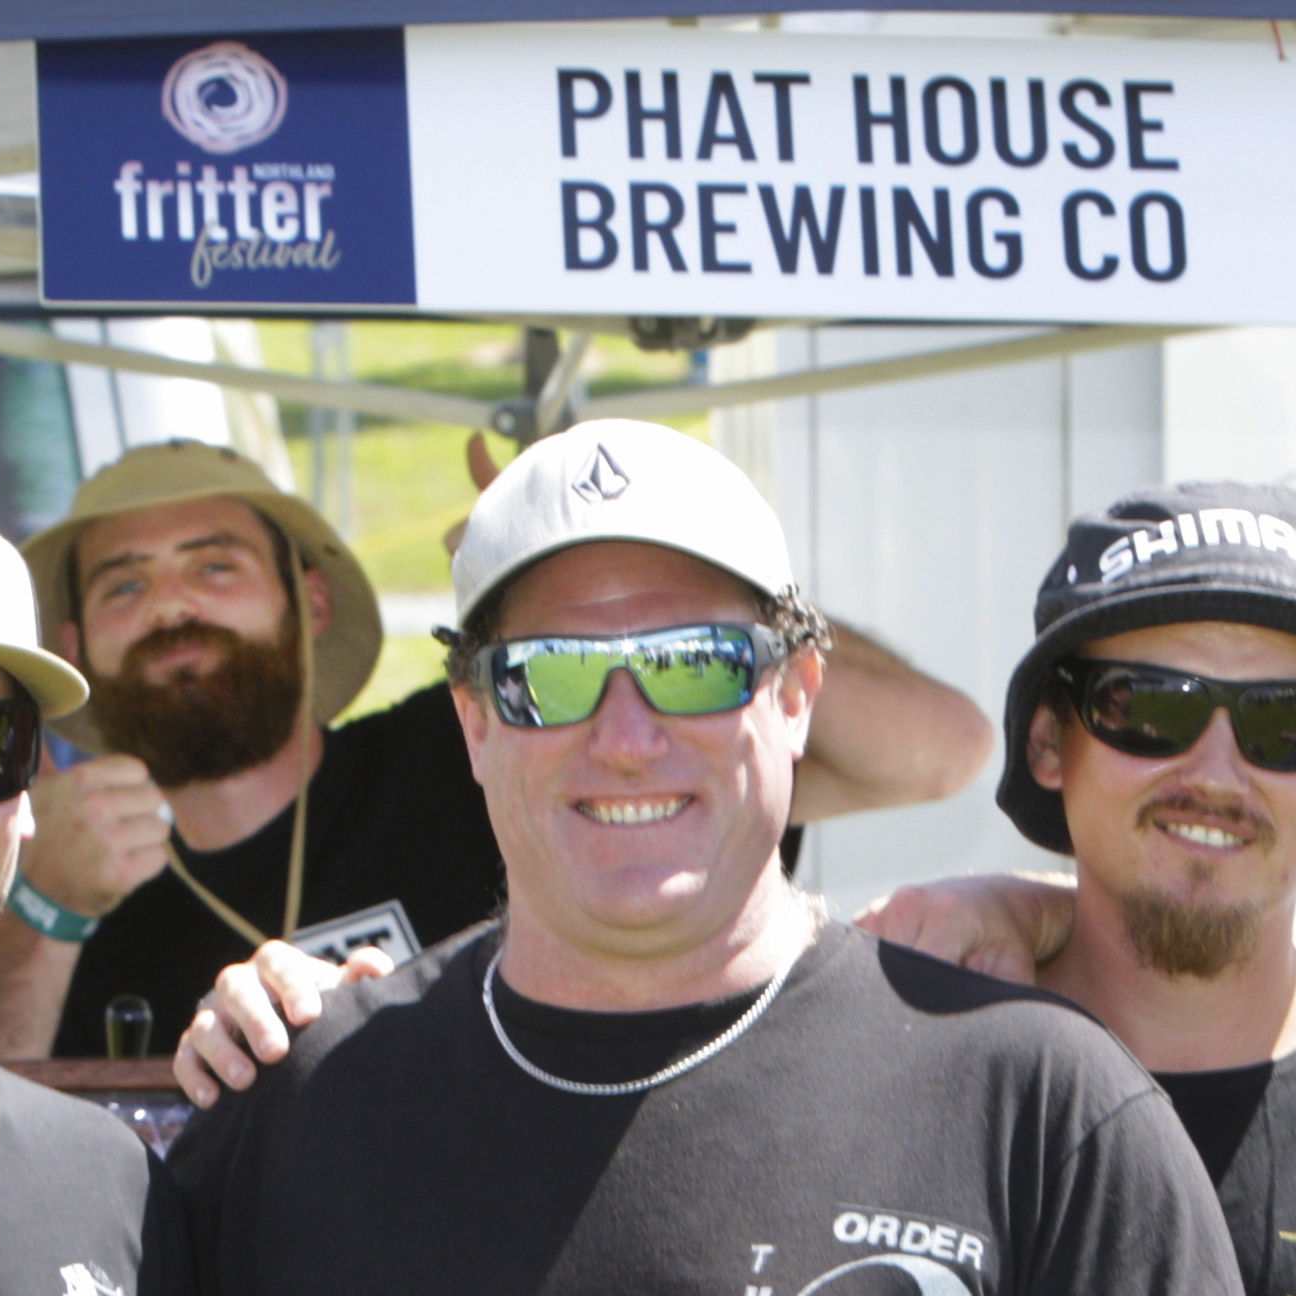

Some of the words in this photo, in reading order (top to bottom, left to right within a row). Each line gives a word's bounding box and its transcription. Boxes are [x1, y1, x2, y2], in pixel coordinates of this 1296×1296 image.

[557, 66, 811, 162] PHAT
[851, 73, 1181, 171] HOUSE
[113, 160, 333, 242] fritter
[253, 162, 335, 181] NORTHLAND
[190, 229, 341, 289] festival
[560, 180, 1024, 279] BREWING
[1061, 188, 1188, 283] CO
[833, 1211, 985, 1271] ORDER
